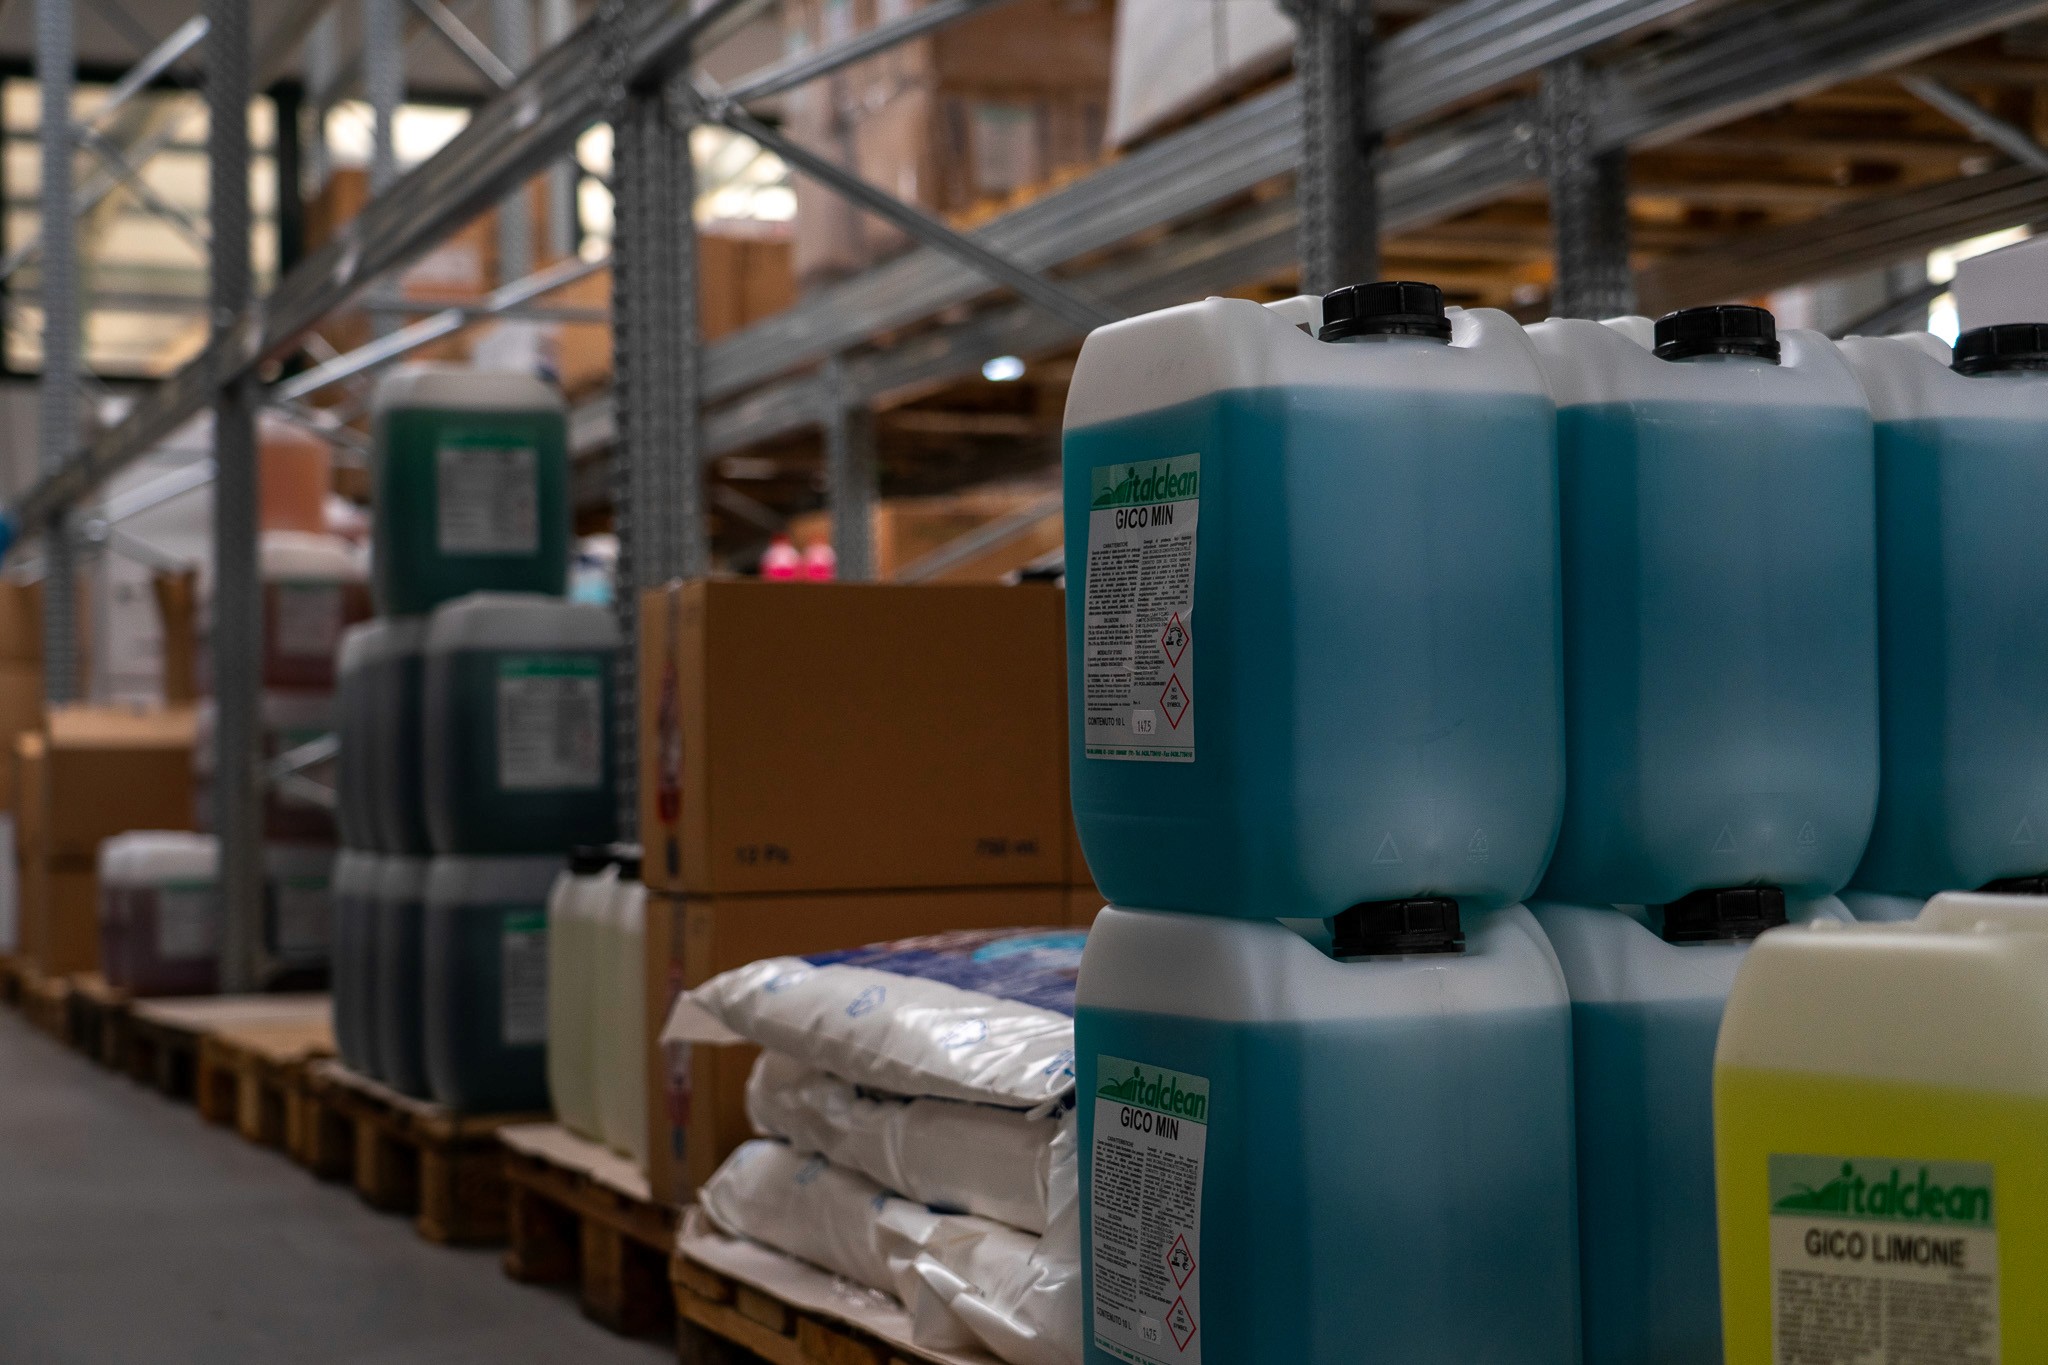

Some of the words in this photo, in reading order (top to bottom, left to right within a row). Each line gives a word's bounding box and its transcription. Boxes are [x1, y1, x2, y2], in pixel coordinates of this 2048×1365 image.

[1115, 507, 1148, 530] GICO
[1151, 504, 1174, 527] MIN
[1087, 716, 1115, 726] CONTENUTO
[1120, 1106, 1153, 1133] GICO
[1155, 1114, 1180, 1141] MIN
[1804, 1227, 1867, 1261] GICO
[1871, 1232, 1967, 1270] LIMONE
[1096, 1307, 1122, 1326] CONTENUTO
